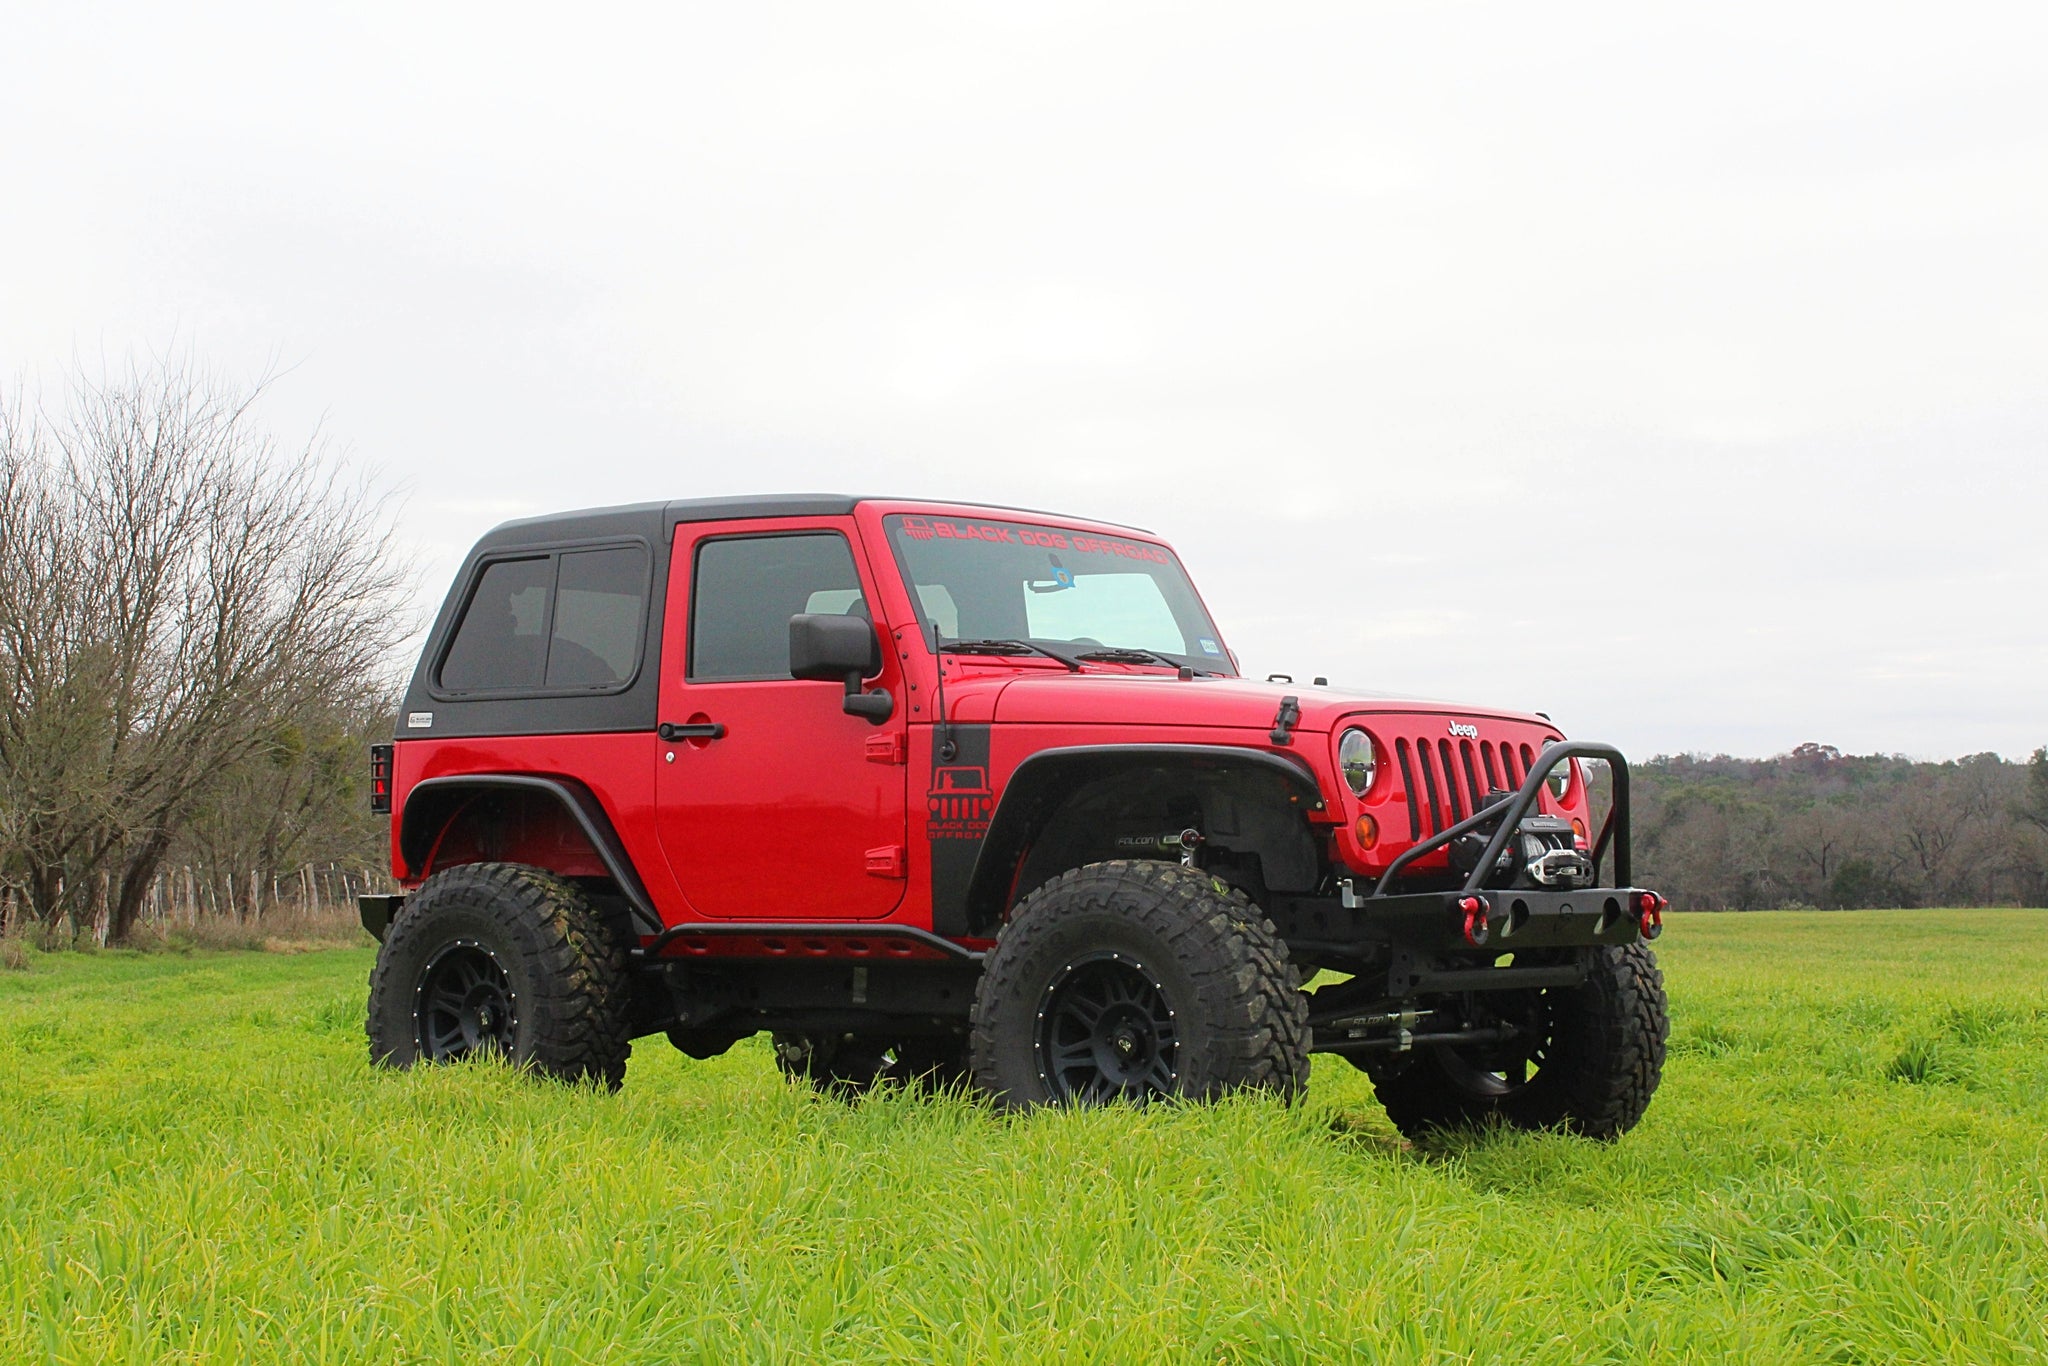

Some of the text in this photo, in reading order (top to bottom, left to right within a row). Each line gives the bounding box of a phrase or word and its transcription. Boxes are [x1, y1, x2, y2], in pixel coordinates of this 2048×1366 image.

[933, 522, 1169, 565] BLACK DOG OFFROAD
[1448, 720, 1478, 740] Jeep
[927, 821, 964, 830] BLACK
[927, 831, 988, 840] OFFROA
[1118, 836, 1155, 846] FALCON
